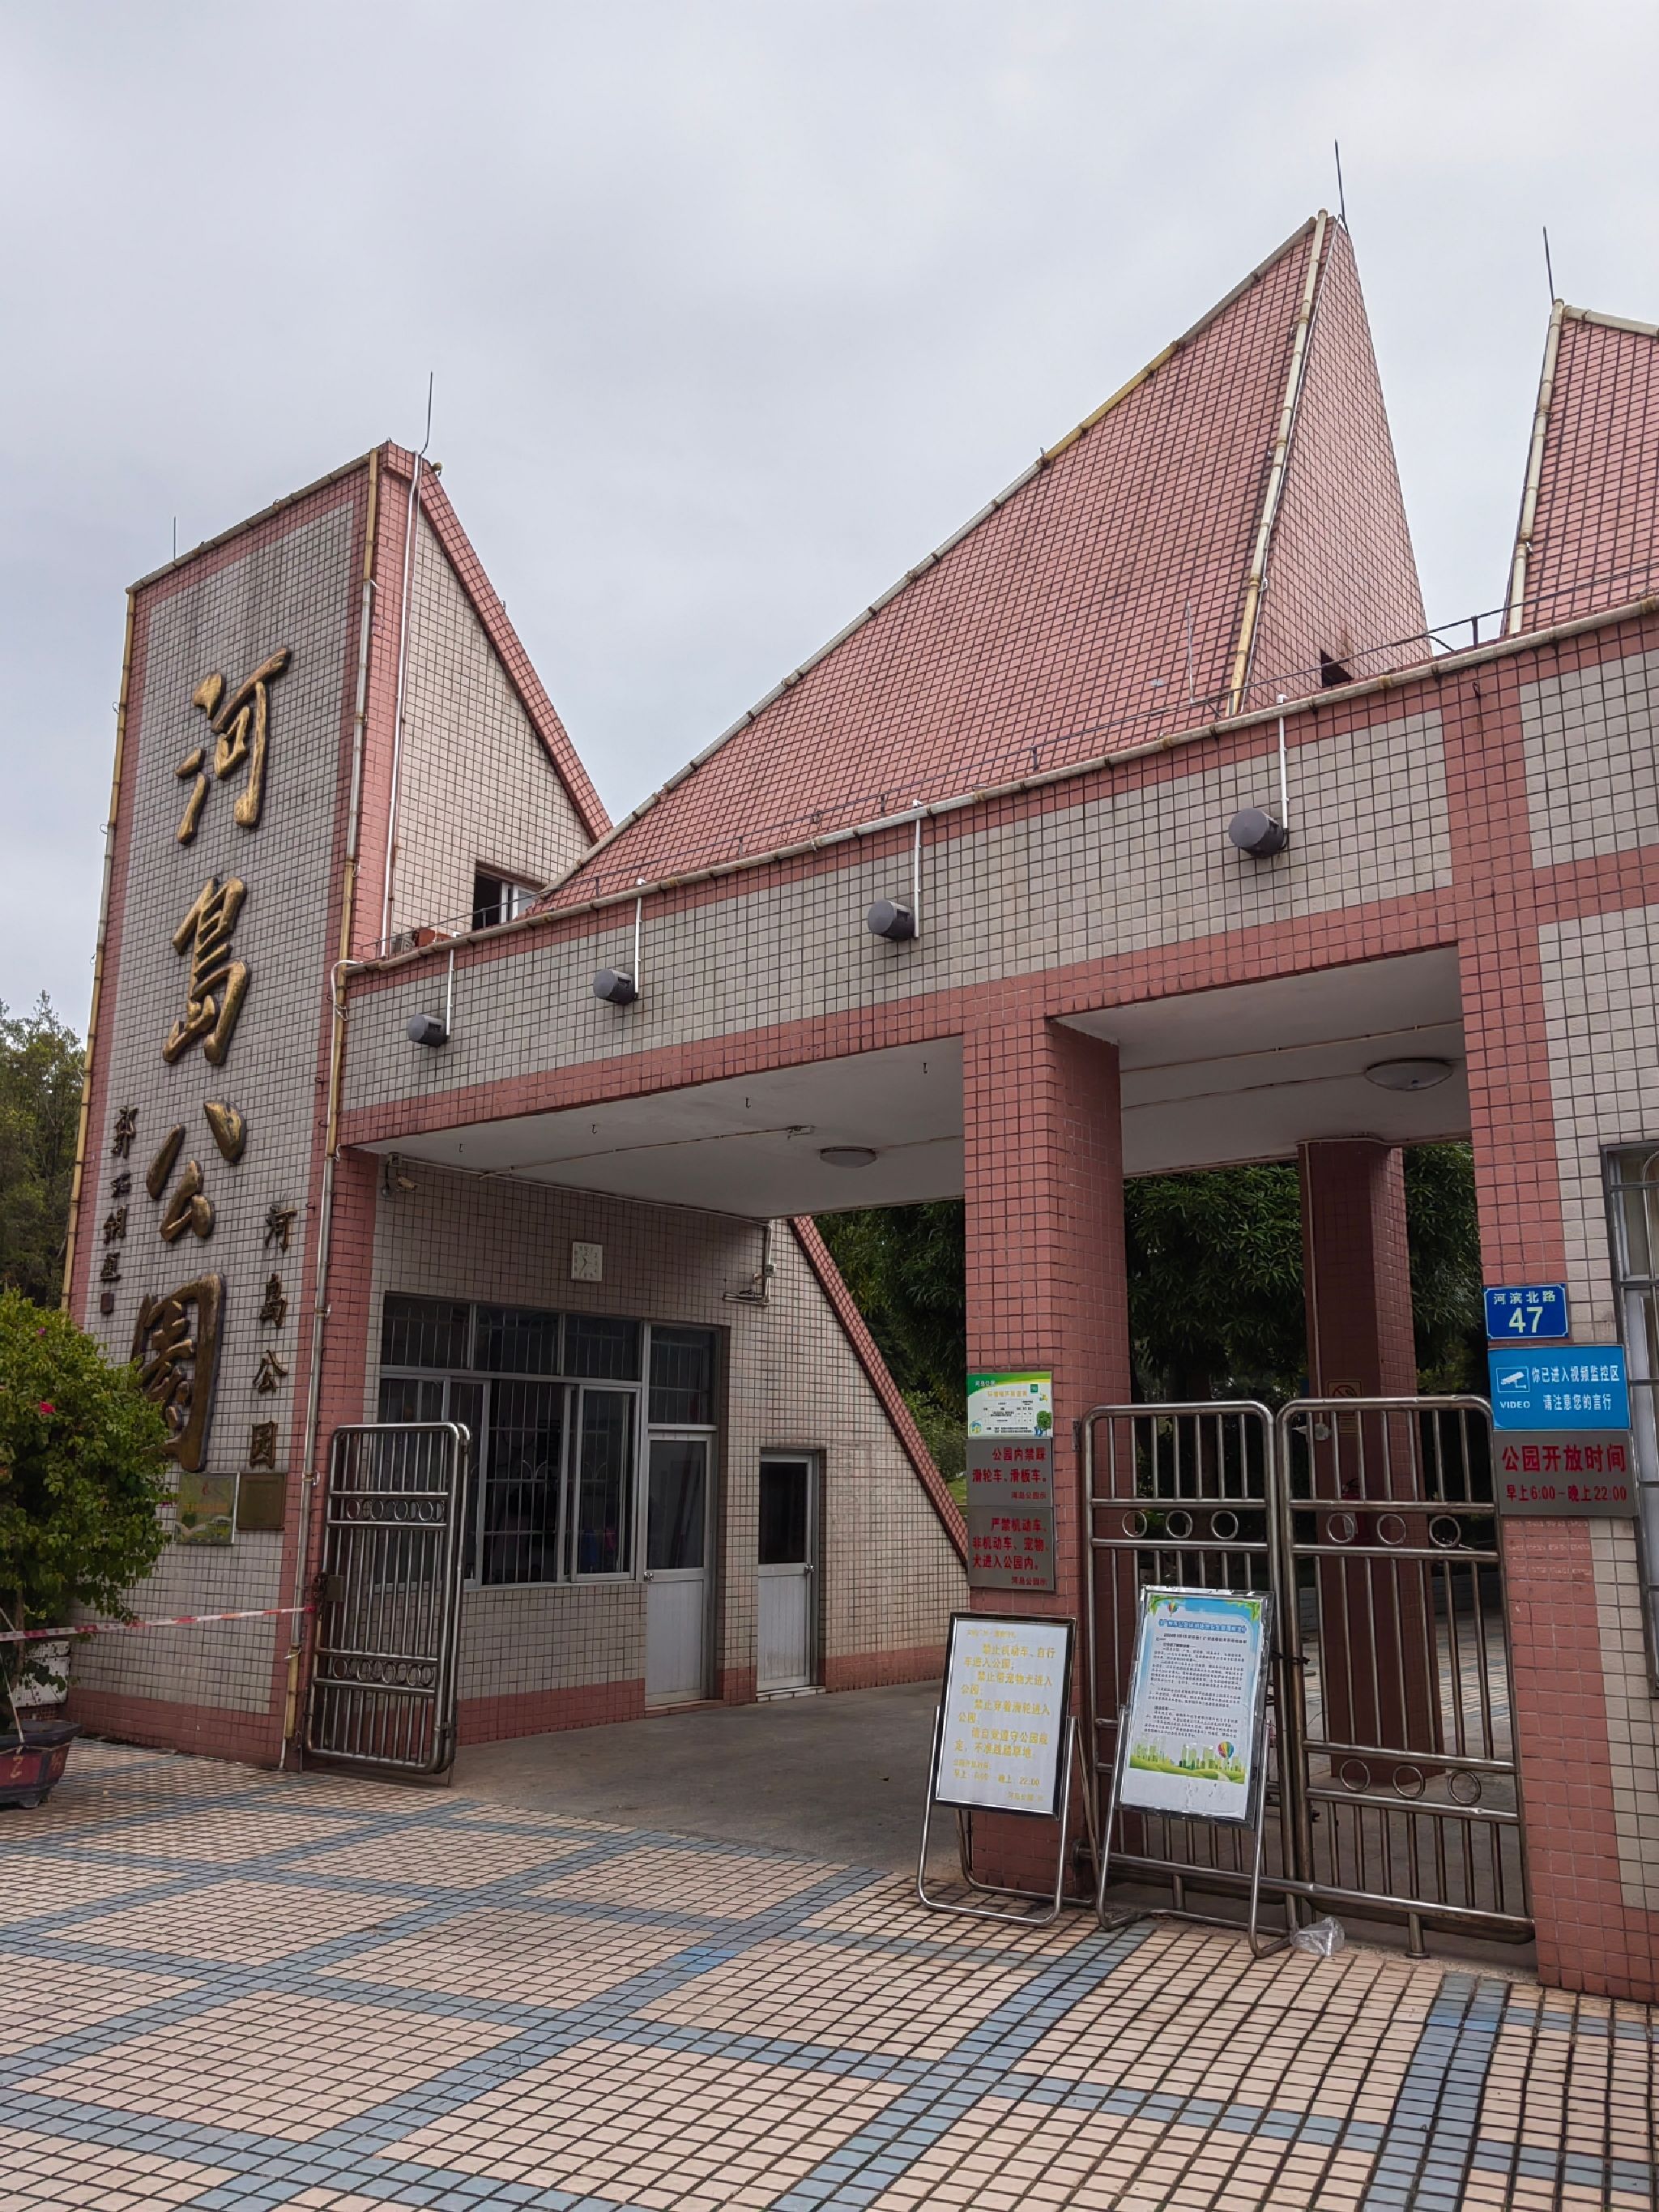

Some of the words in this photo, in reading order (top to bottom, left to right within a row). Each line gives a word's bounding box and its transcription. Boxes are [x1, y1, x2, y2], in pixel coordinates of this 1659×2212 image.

[1494, 1290, 1555, 1305] 河滨北路
[1509, 1306, 1543, 1333] 47
[1532, 1364, 1620, 1382] 你已进入视频监控区
[1499, 1400, 1530, 1409] VIDEO
[1543, 1394, 1611, 1411] 请注意您的言行
[1502, 1443, 1627, 1471] 公园开放时间
